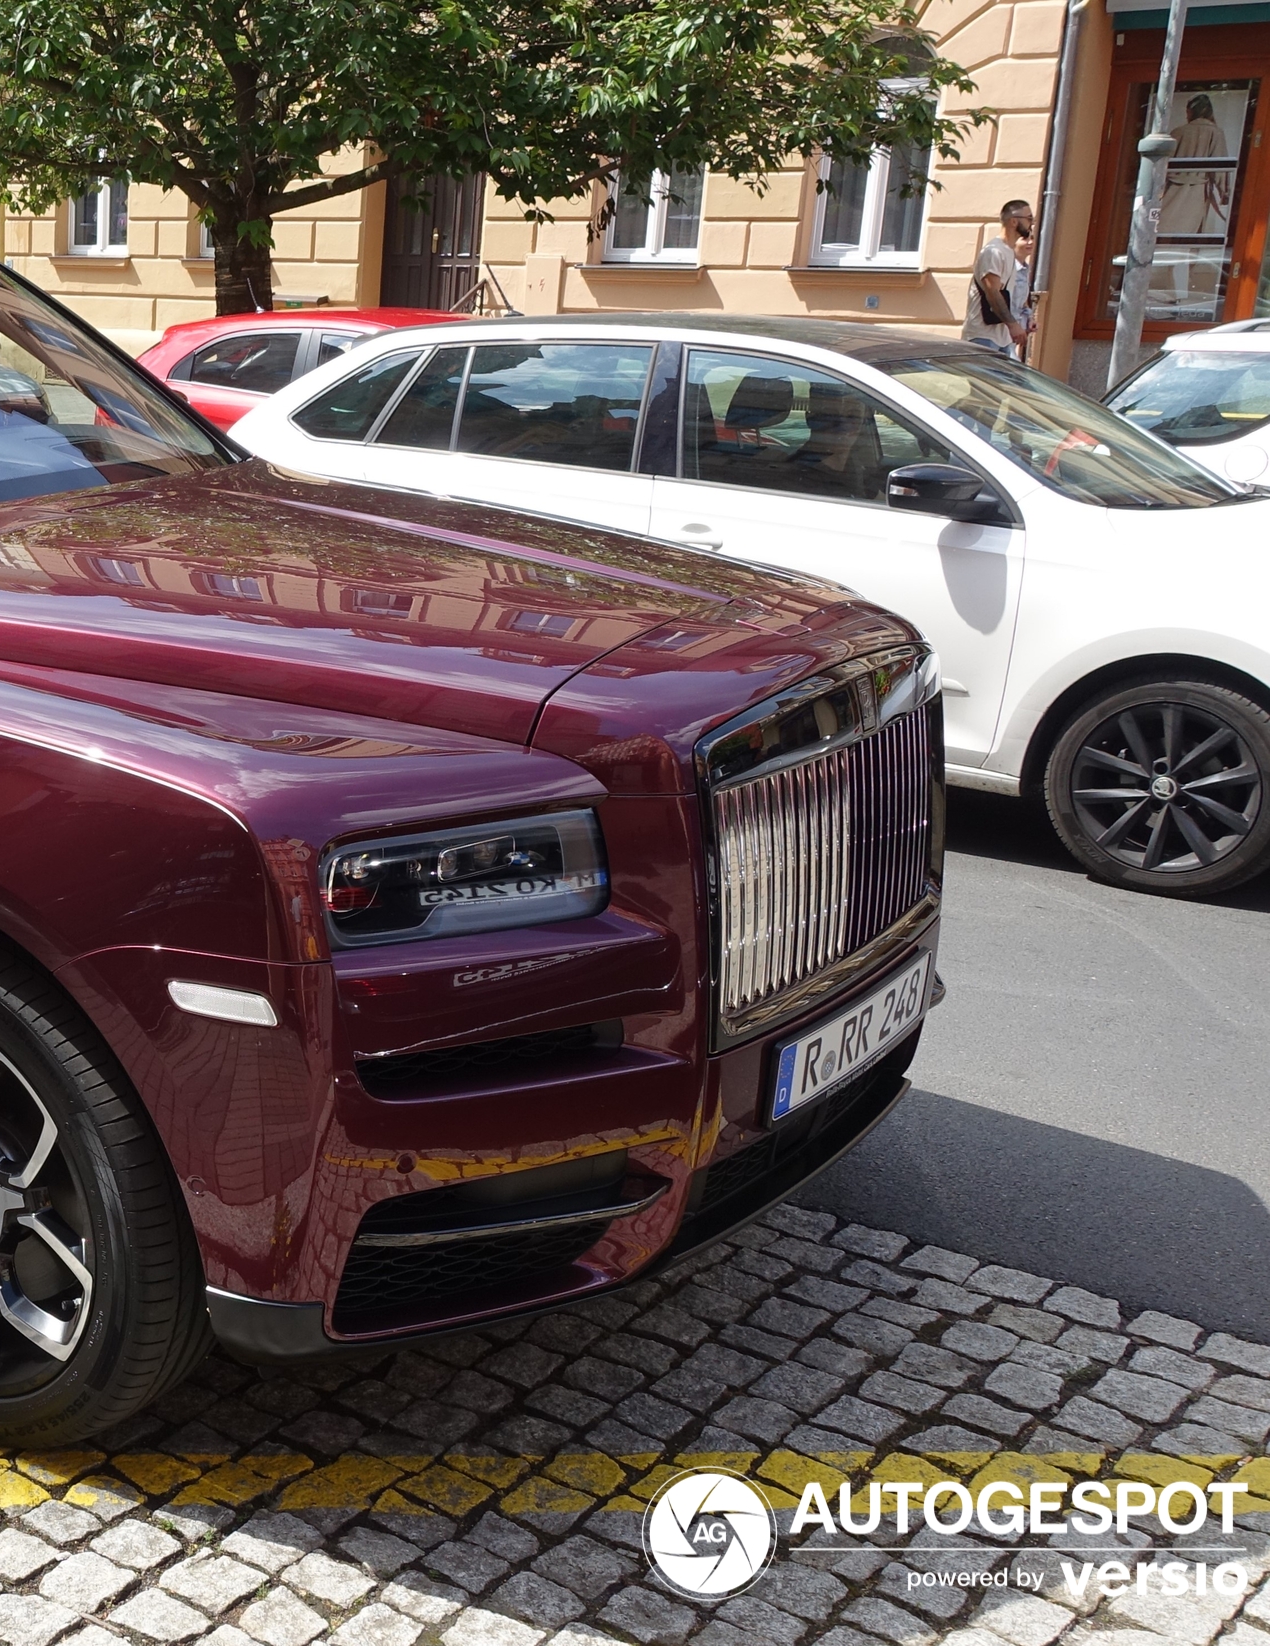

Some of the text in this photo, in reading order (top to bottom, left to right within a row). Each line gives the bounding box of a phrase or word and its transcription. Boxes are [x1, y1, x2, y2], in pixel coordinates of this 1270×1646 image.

[801, 967, 921, 1095] R RR 248
[778, 1087, 787, 1103] D
